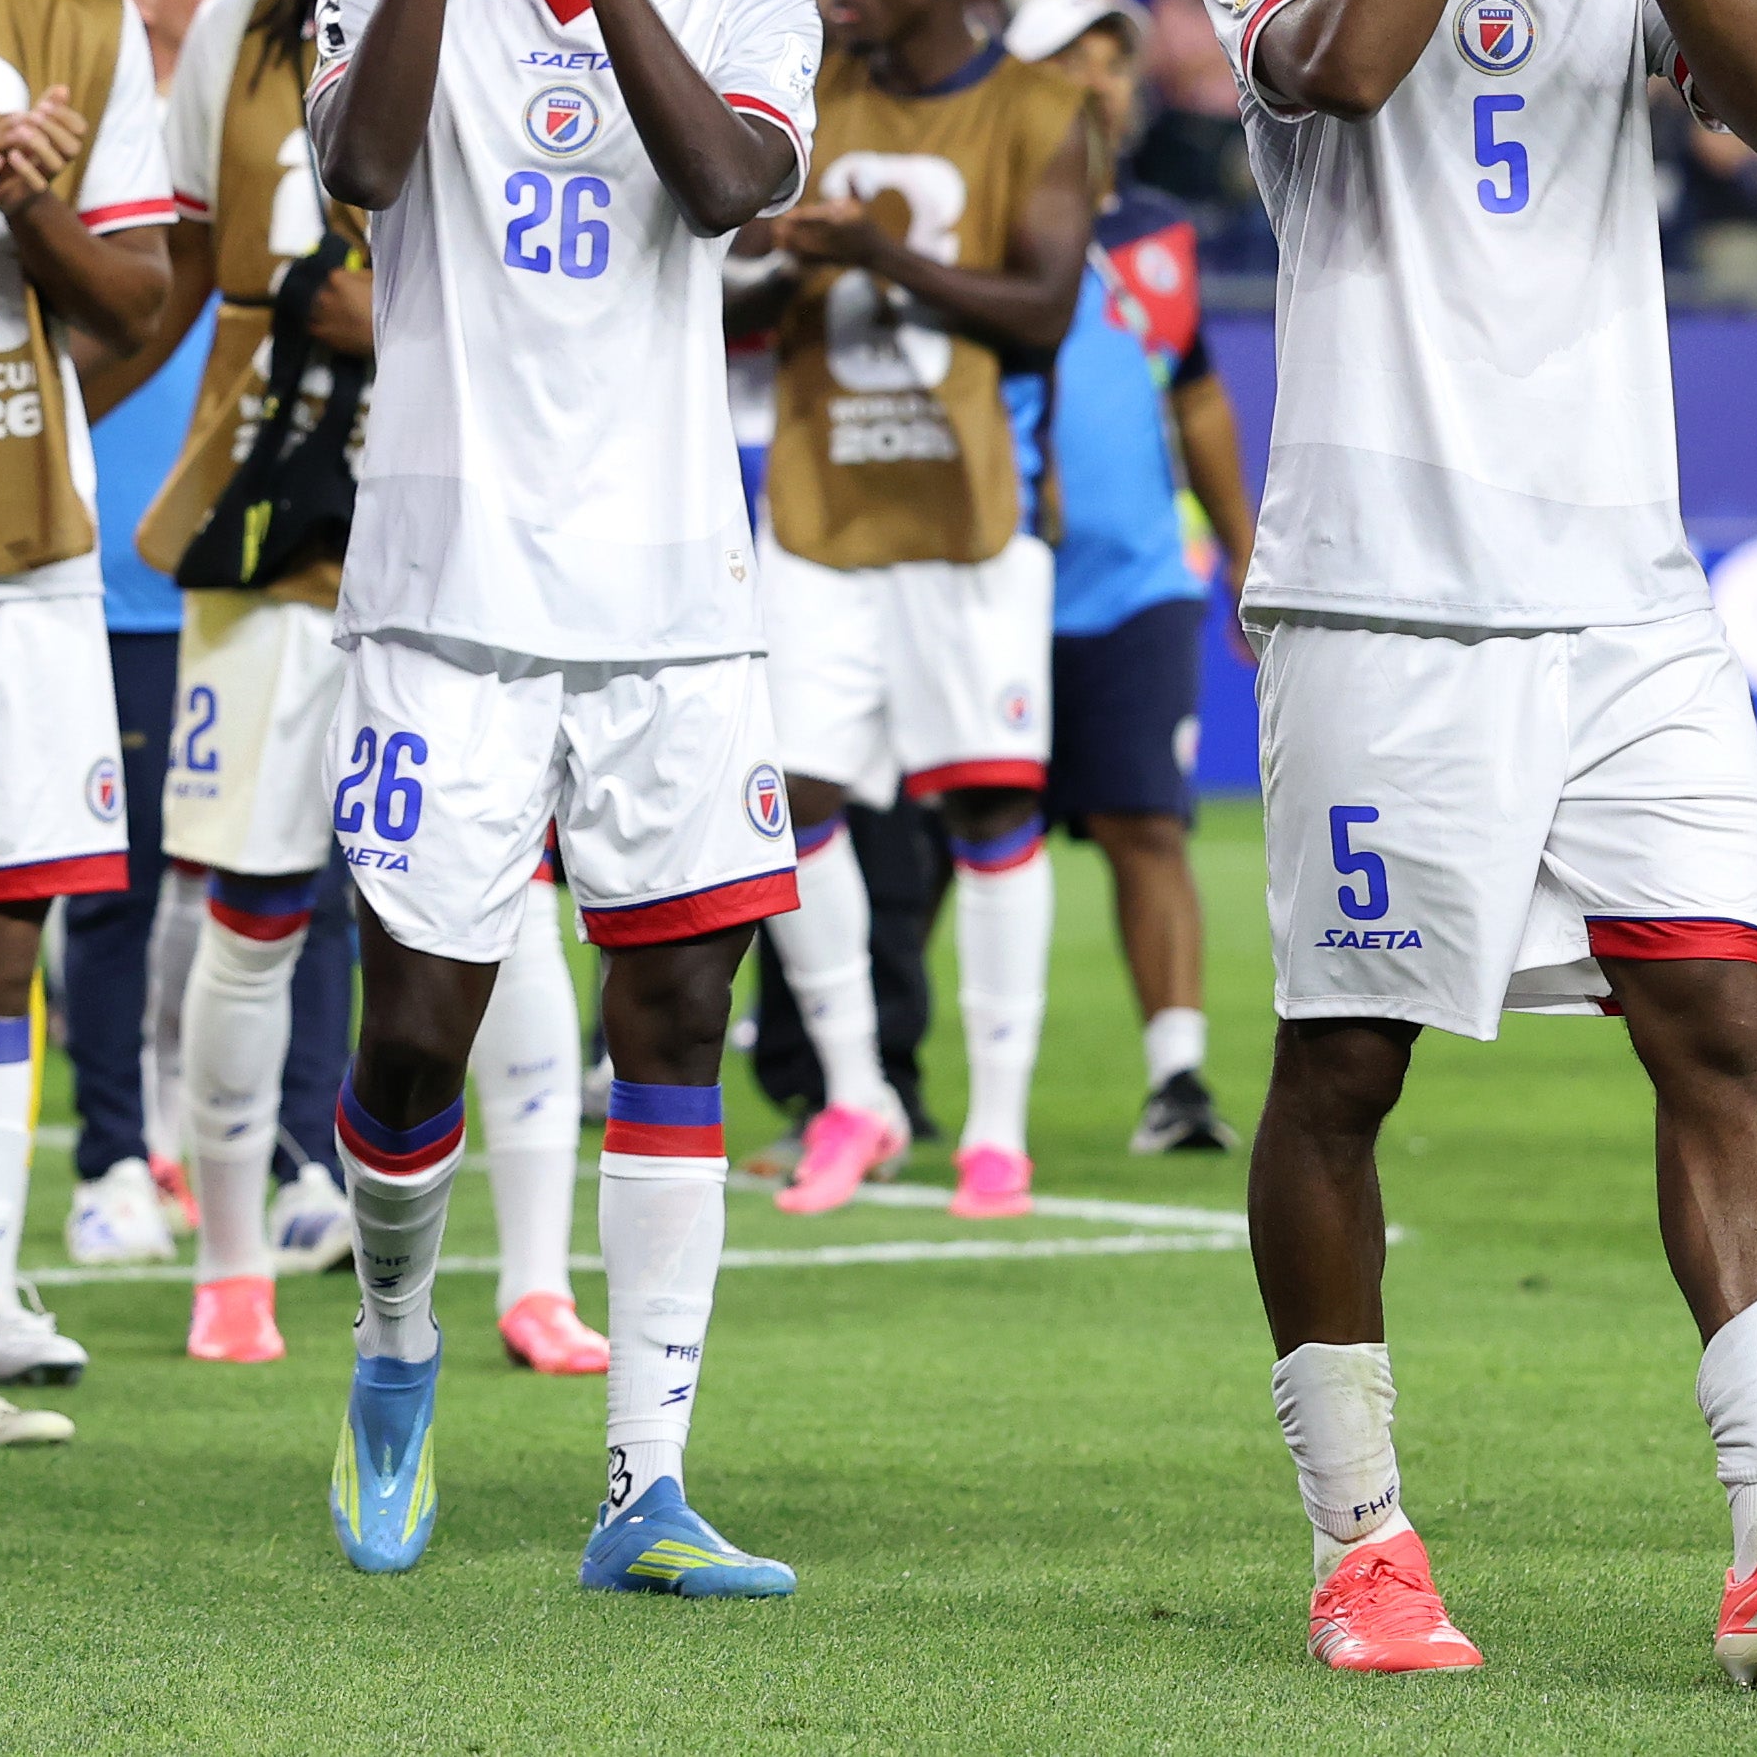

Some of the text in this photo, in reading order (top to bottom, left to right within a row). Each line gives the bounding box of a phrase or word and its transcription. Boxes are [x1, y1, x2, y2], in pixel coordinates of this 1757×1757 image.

[1473, 94, 1530, 214] 5
[504, 171, 612, 279] 26
[171, 685, 219, 772] 2
[334, 726, 429, 842] 26
[344, 846, 409, 873] AETA
[1329, 805, 1390, 921] 5
[1314, 929, 1423, 950] SAETA
[1353, 1485, 1395, 1522] FHF
